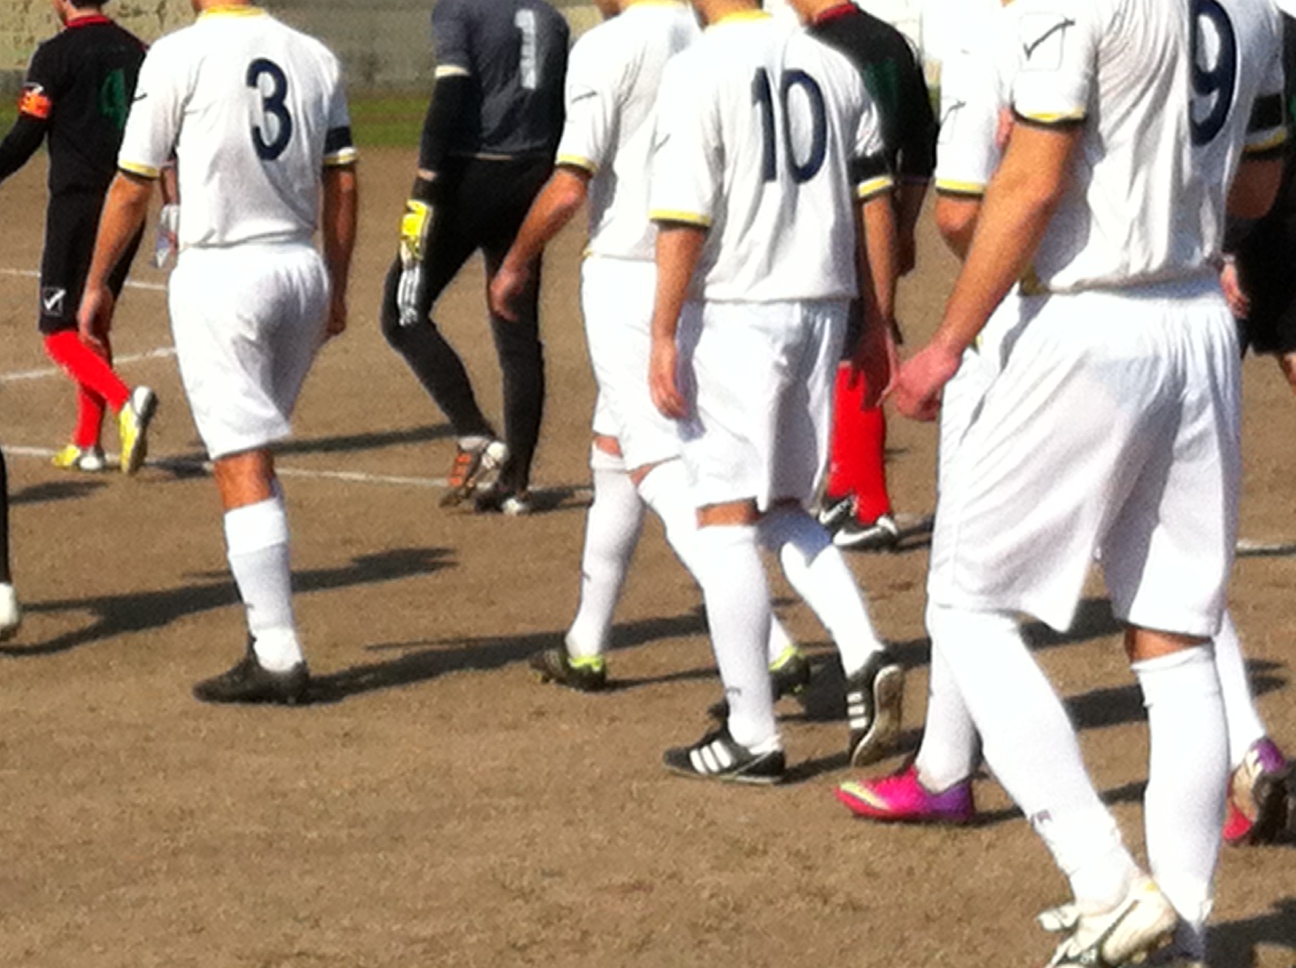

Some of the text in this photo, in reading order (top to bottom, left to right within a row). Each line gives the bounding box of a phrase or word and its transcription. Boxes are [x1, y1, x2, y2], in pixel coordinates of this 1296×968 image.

[515, 9, 536, 89] 1
[246, 57, 292, 160] 3
[752, 67, 828, 184] 10
